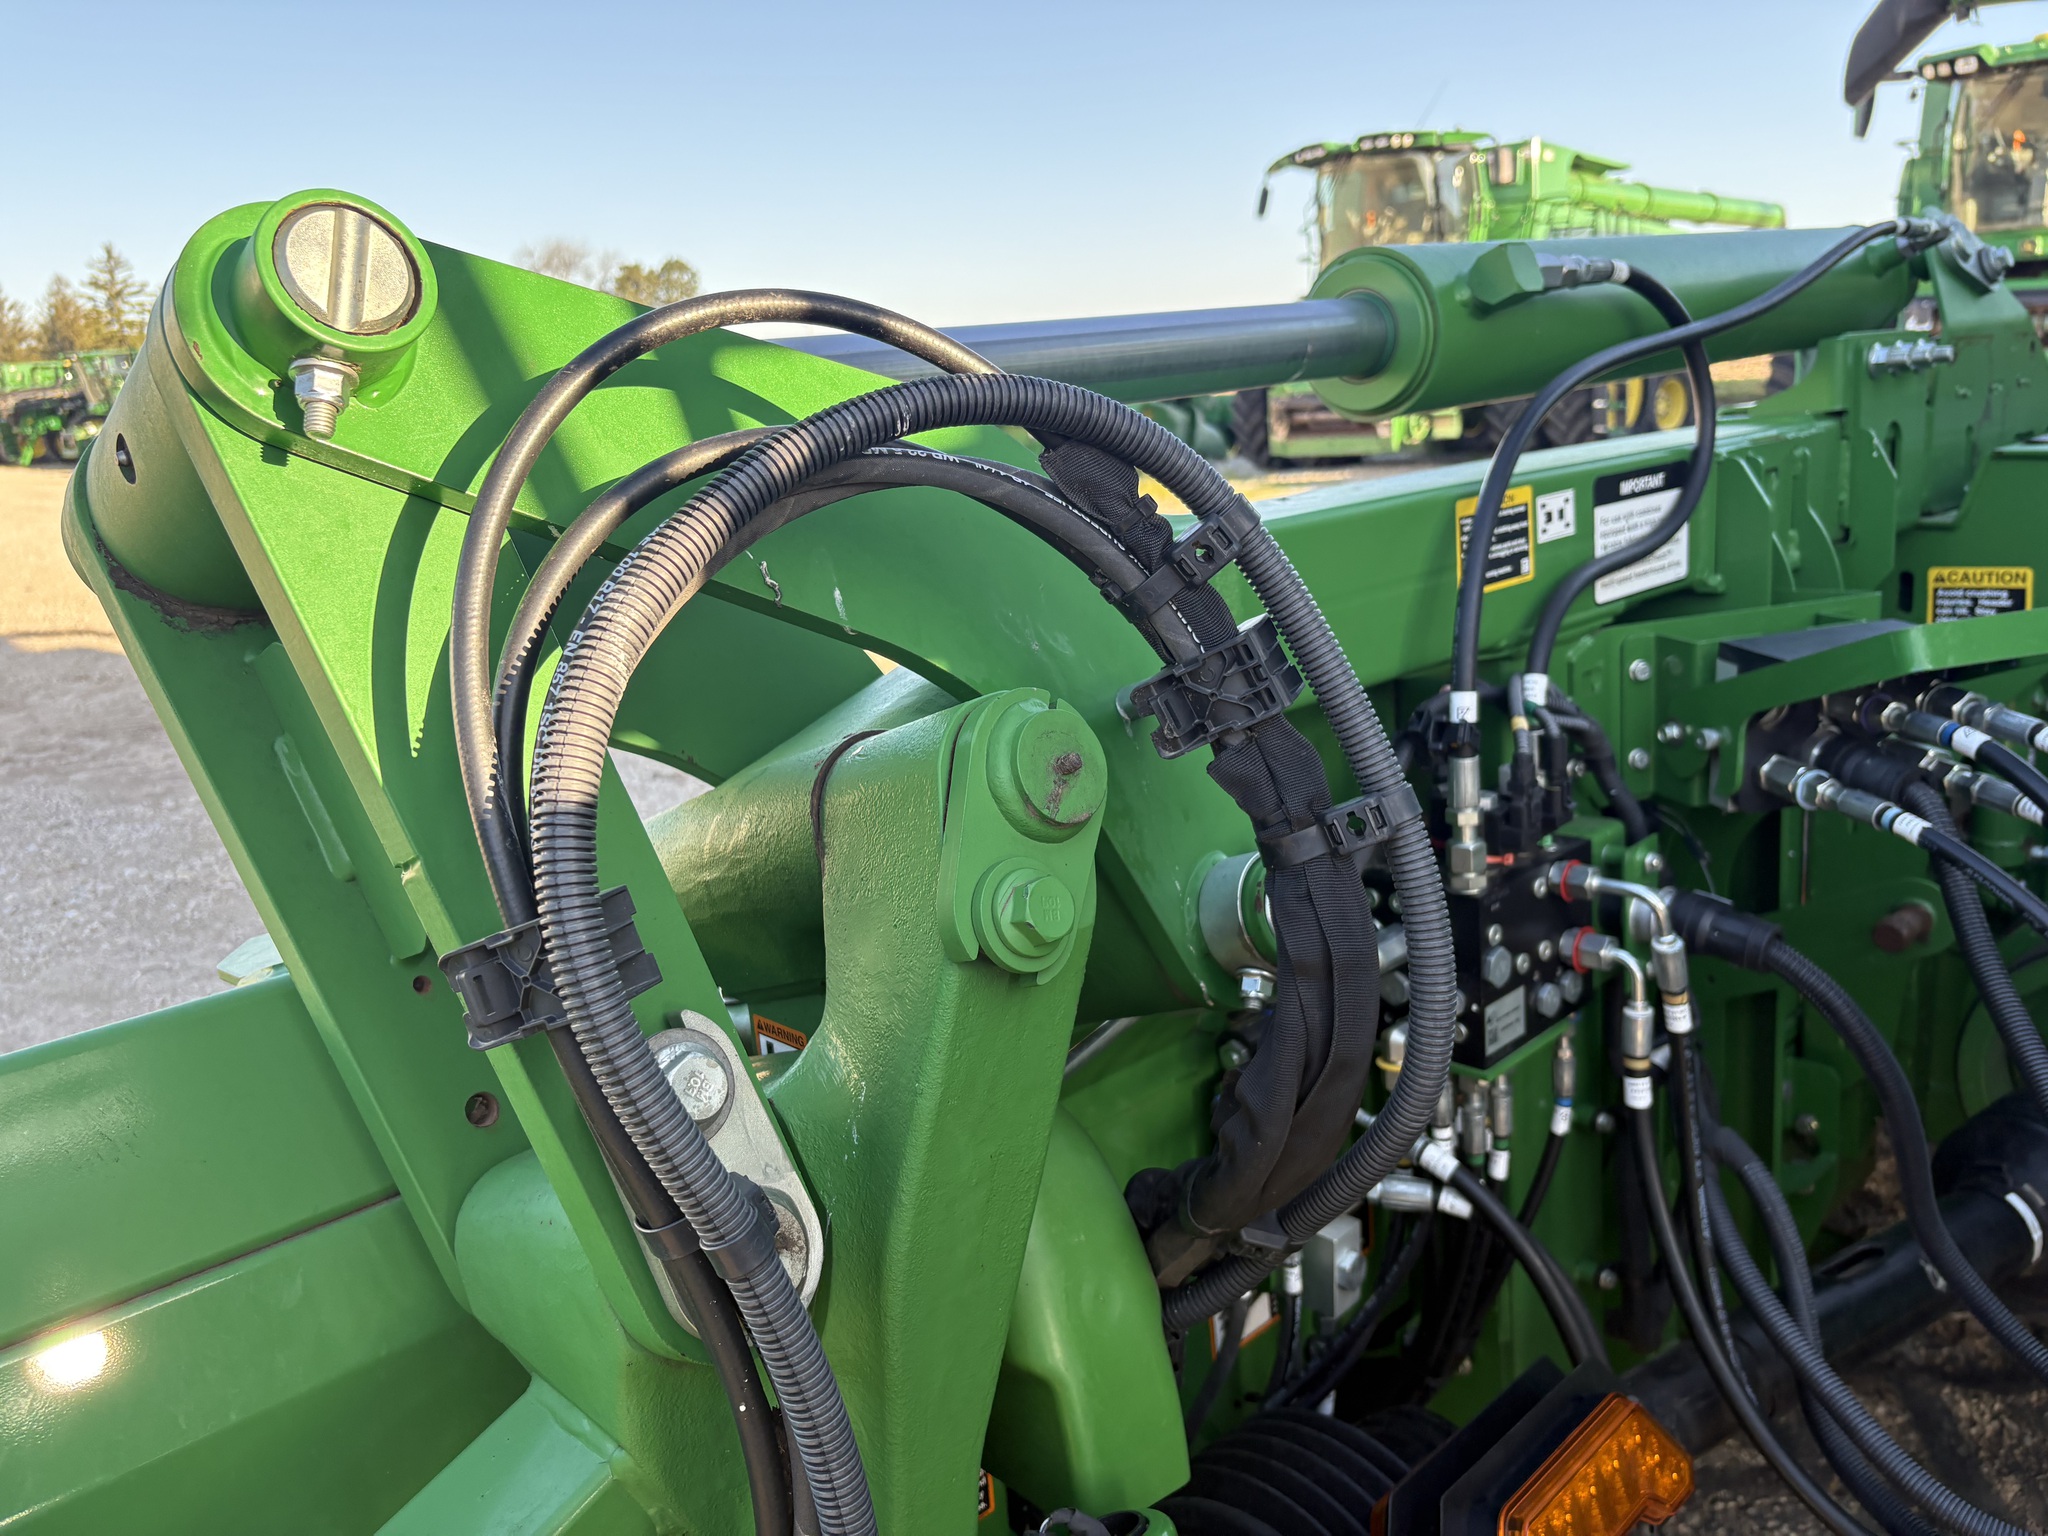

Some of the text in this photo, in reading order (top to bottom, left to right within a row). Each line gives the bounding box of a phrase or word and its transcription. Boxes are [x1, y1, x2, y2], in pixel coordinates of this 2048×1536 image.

[1619, 471, 1666, 496] IMPORTANT
[612, 551, 639, 577] 100
[1947, 569, 2027, 585] CAUTION
[588, 580, 616, 614] R17
[563, 630, 584, 657] EN
[550, 661, 568, 696] 857
[763, 1021, 805, 1047] WARNING
